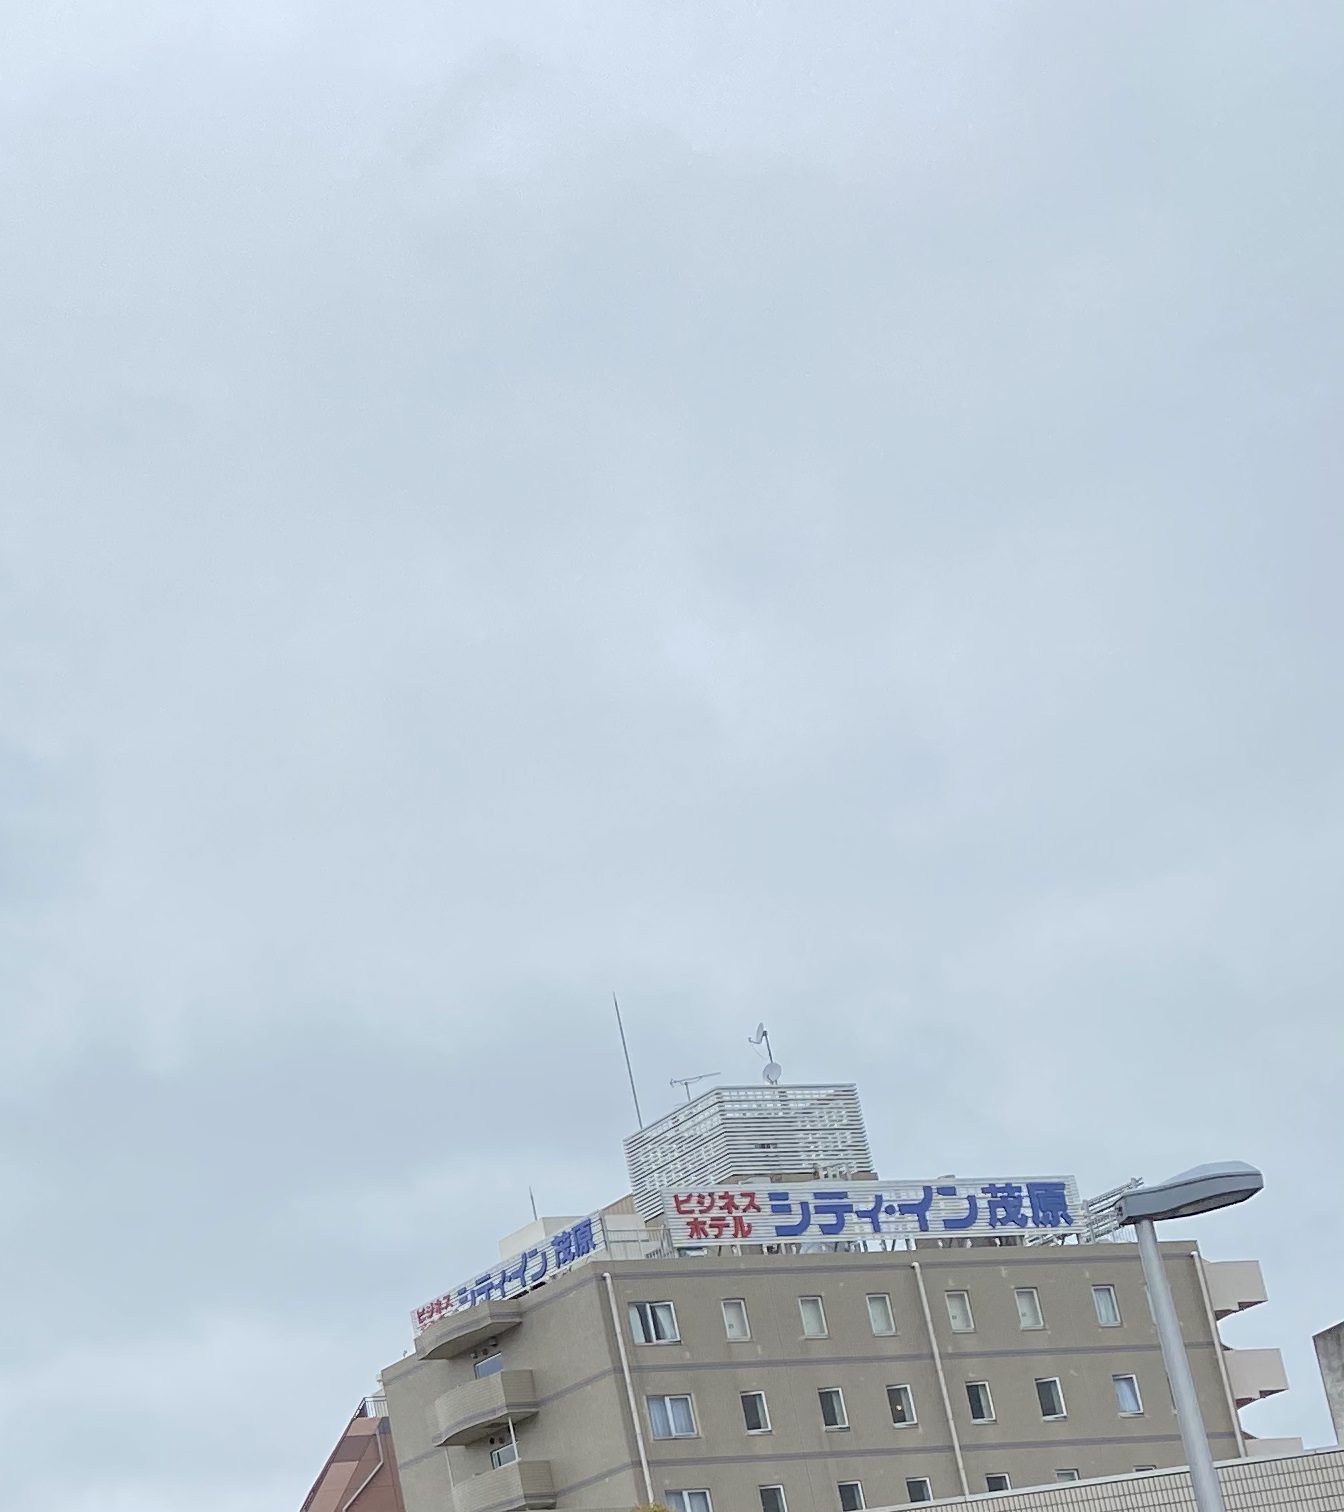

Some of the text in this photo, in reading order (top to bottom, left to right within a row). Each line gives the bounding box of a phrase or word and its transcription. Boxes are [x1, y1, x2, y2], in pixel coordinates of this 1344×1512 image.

[673, 1191, 761, 1215] ビジネス
[686, 1217, 752, 1239] ホテル
